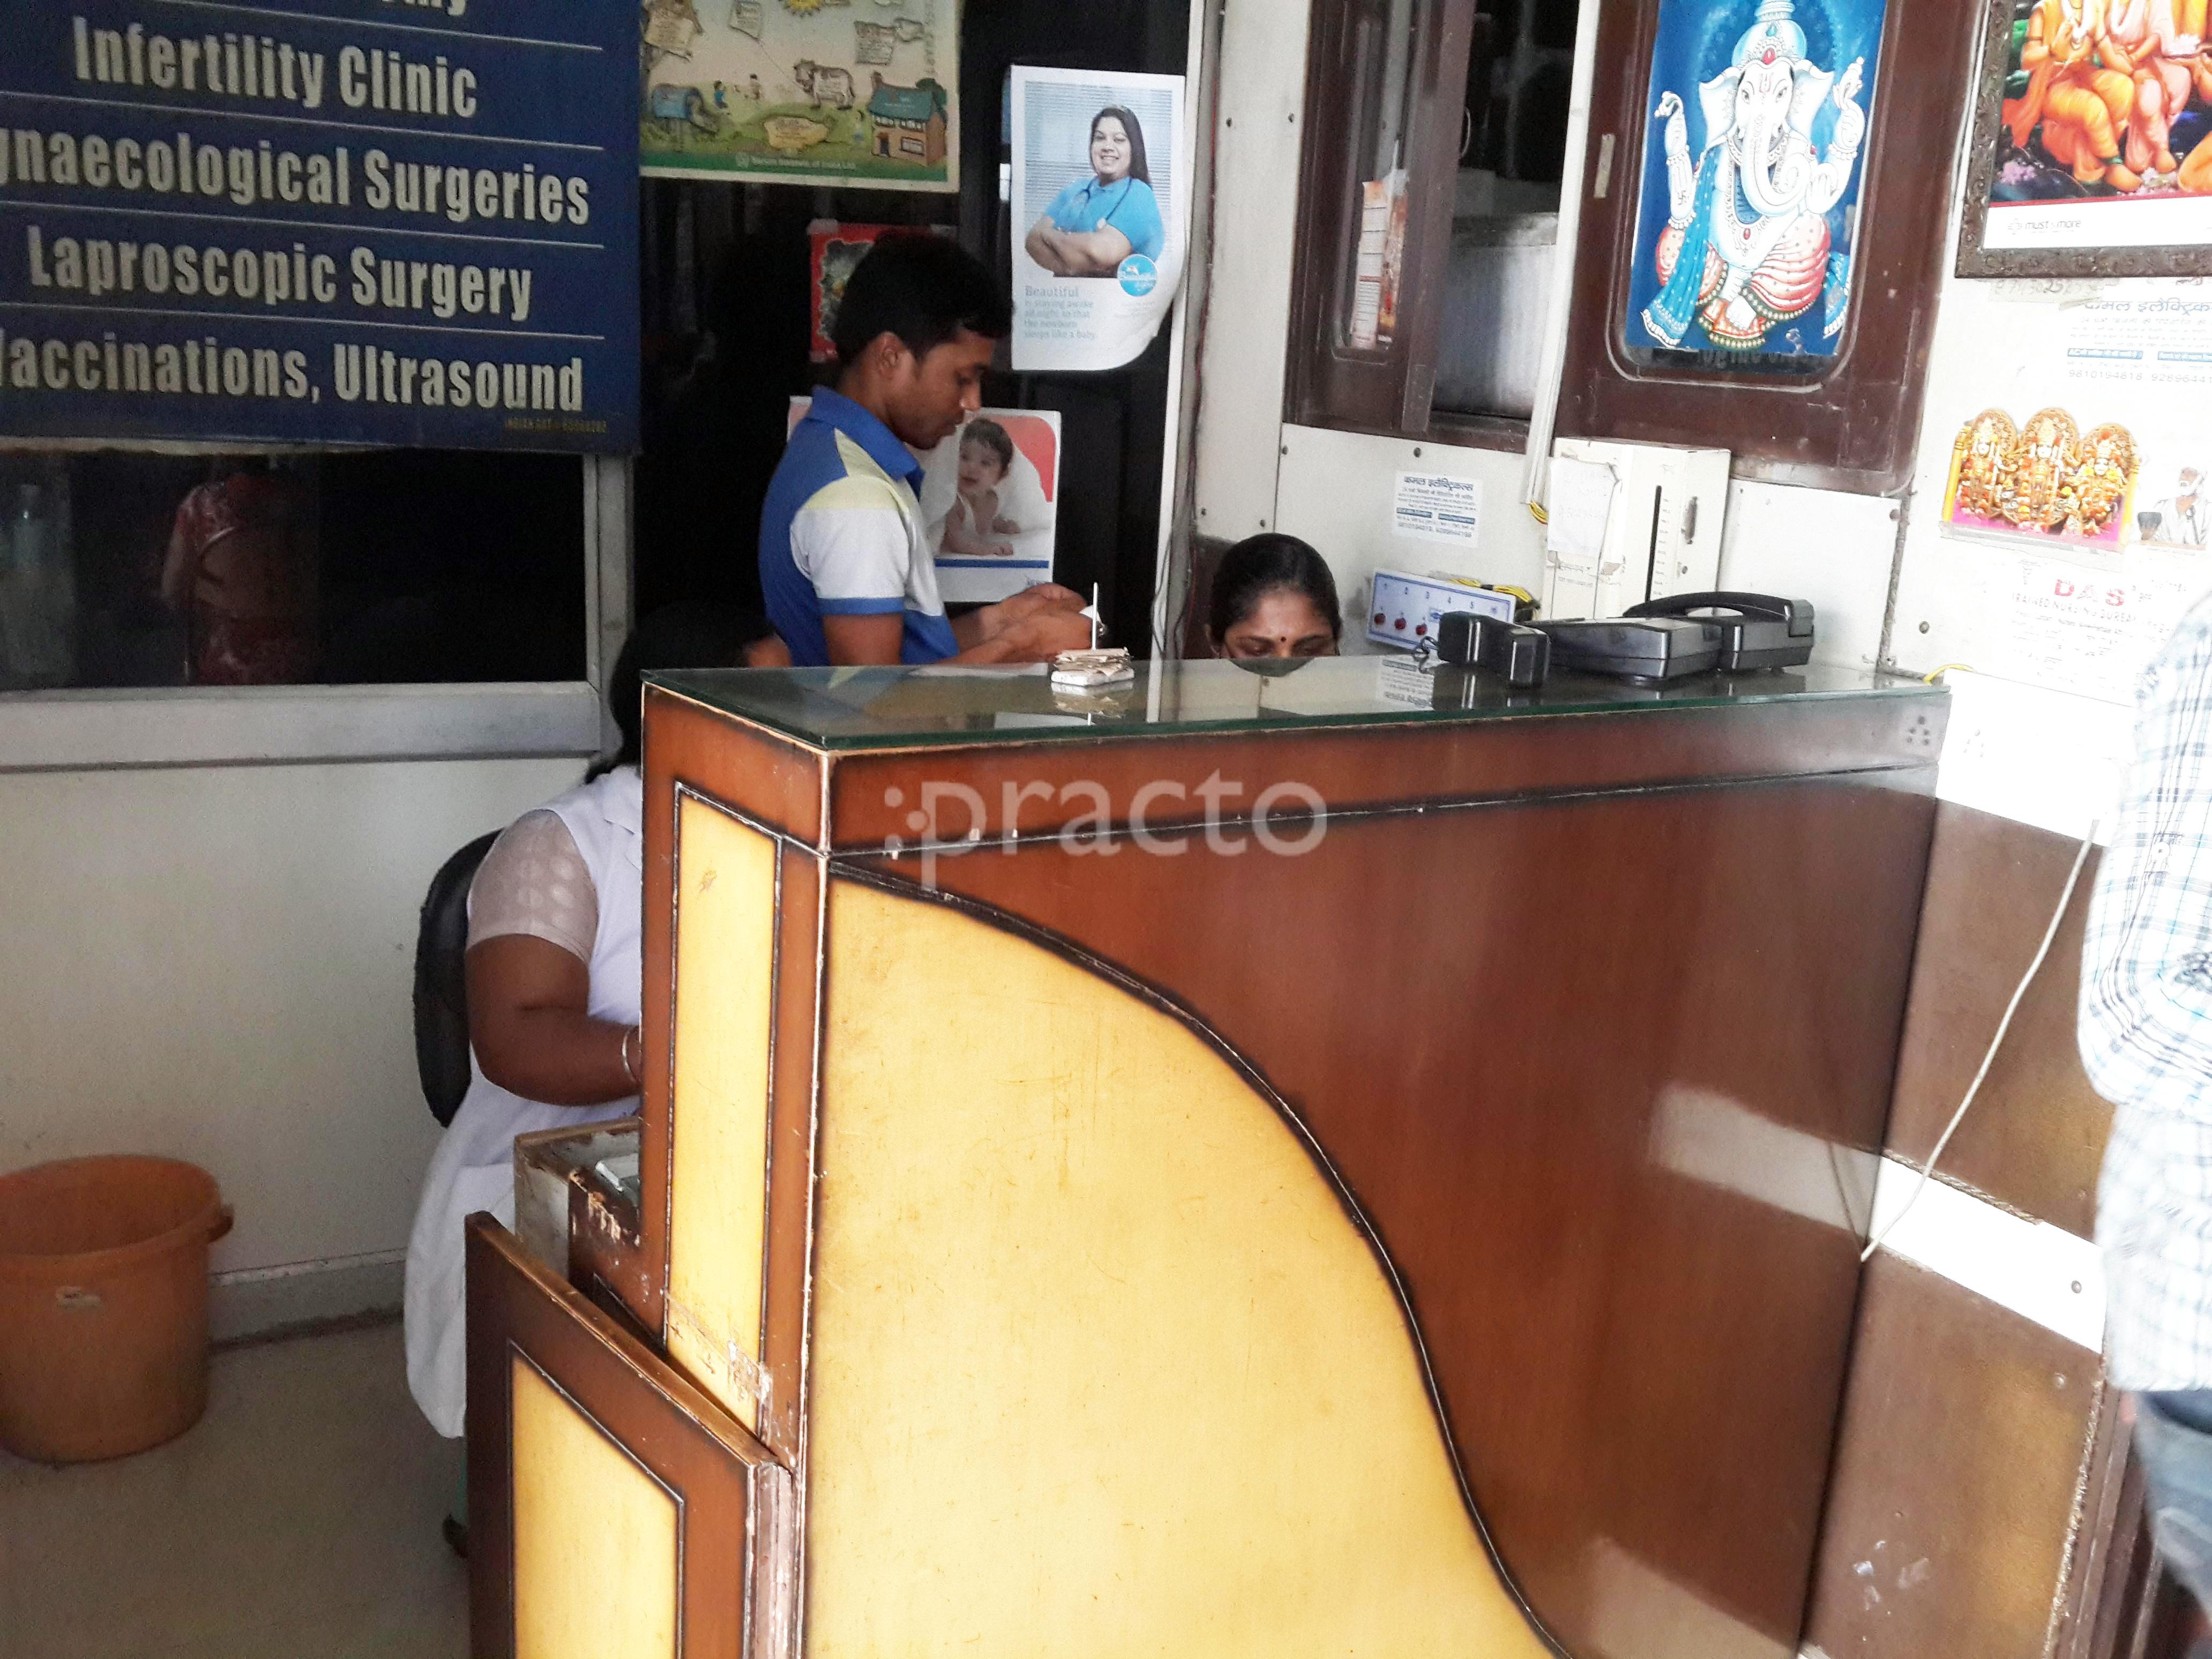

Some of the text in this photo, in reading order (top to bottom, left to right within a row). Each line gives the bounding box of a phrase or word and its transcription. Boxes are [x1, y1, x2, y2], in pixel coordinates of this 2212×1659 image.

[73, 16, 477, 118] Infertility Clinic
[364, 148, 590, 225] Surgeries
[27, 225, 532, 321] Laproscopic Surgery
[1025, 285, 1079, 297] Beautiful
[0, 328, 584, 412] accinations, Ultrasound
